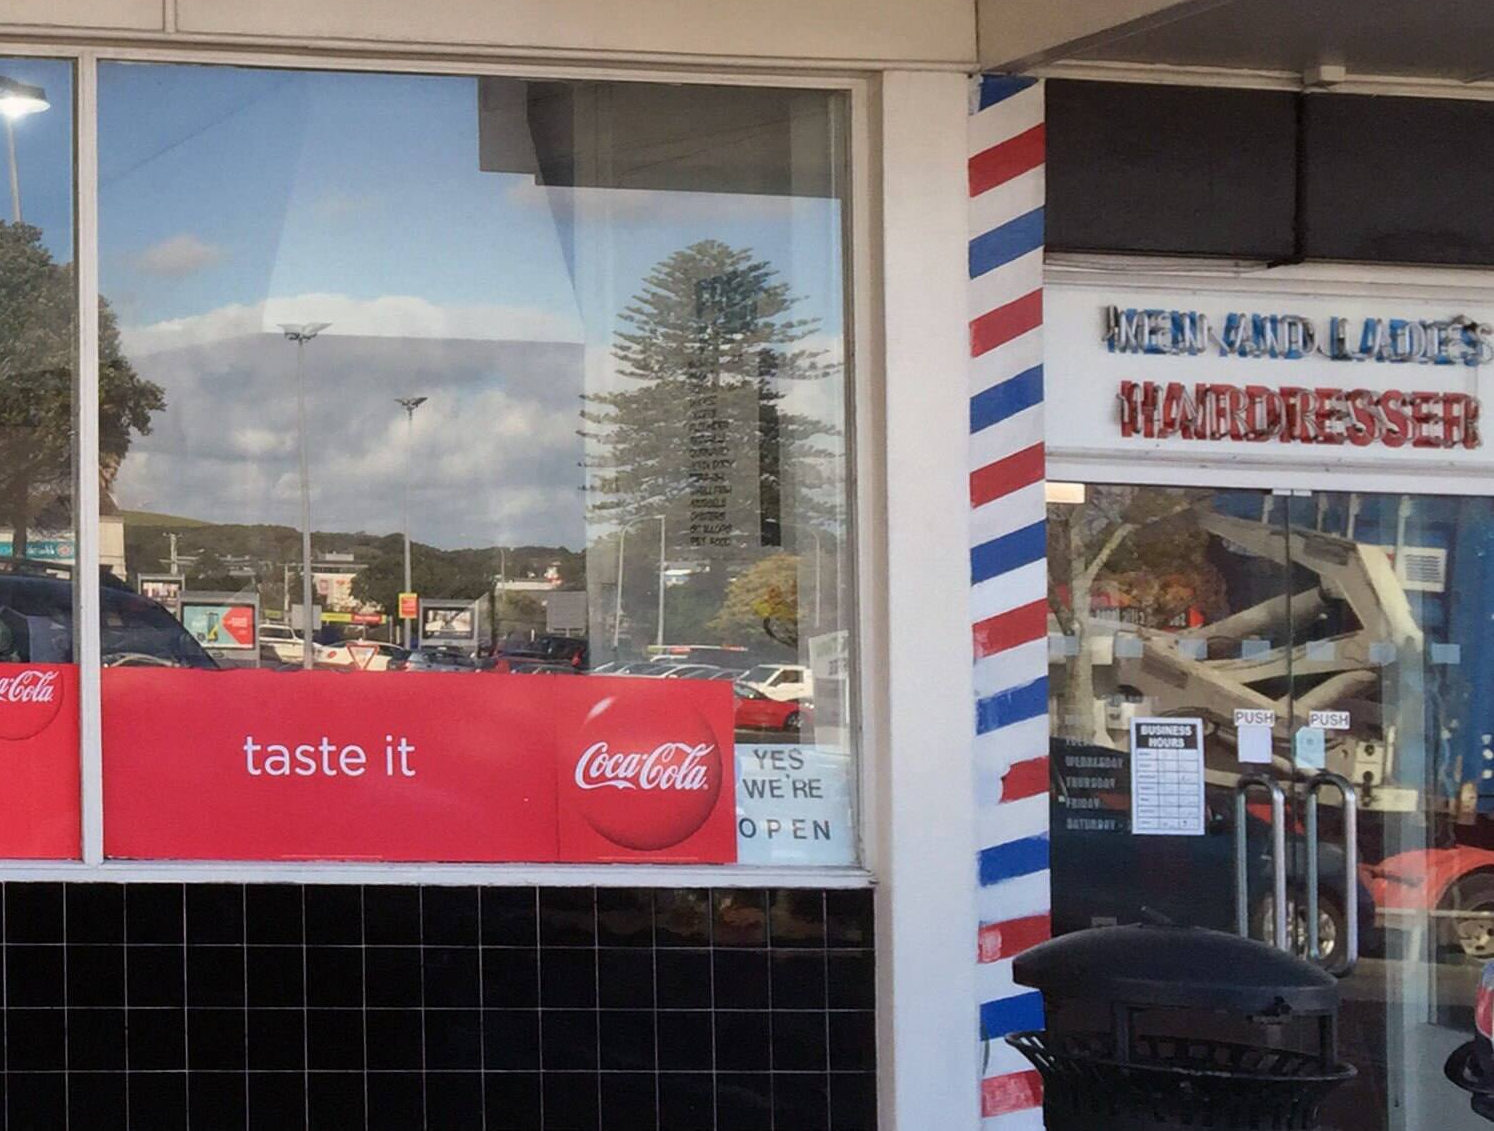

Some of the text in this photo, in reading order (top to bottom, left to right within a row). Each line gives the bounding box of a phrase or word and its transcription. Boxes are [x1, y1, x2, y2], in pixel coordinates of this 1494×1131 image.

[1104, 306, 1206, 355] MEN
[1210, 312, 1316, 360] AND
[1117, 380, 1482, 449] HAIRDRESSER
[1235, 711, 1274, 724] PUSH
[1310, 713, 1349, 726] PUSH
[1139, 724, 1193, 736] BUSINESS
[1148, 738, 1185, 748] HOURS
[243, 734, 415, 776] taste it
[575, 741, 716, 791] Coca-Cola
[753, 748, 804, 770] YES
[742, 774, 823, 799] WE'RE
[739, 817, 831, 840] OPEN
